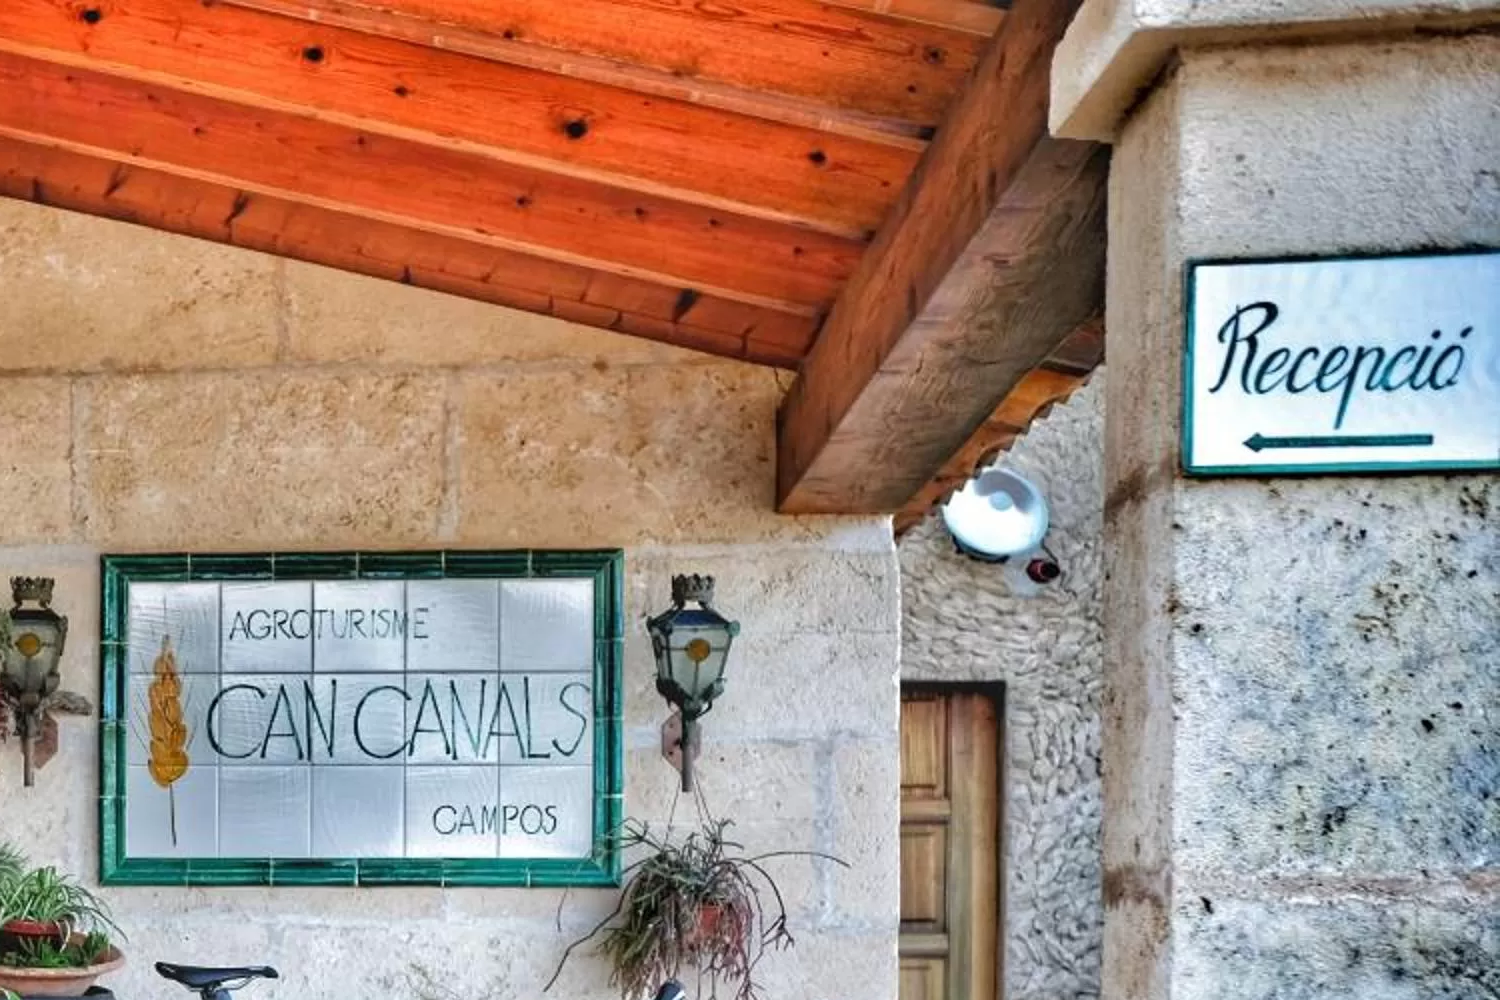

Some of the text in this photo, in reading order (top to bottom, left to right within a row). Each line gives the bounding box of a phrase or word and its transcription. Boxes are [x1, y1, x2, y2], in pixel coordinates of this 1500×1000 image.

[1208, 301, 1474, 430] Recepció
[229, 607, 430, 641] AGROTURISME
[206, 676, 592, 761] CAN CANALS
[432, 804, 558, 836] CAMPOS
